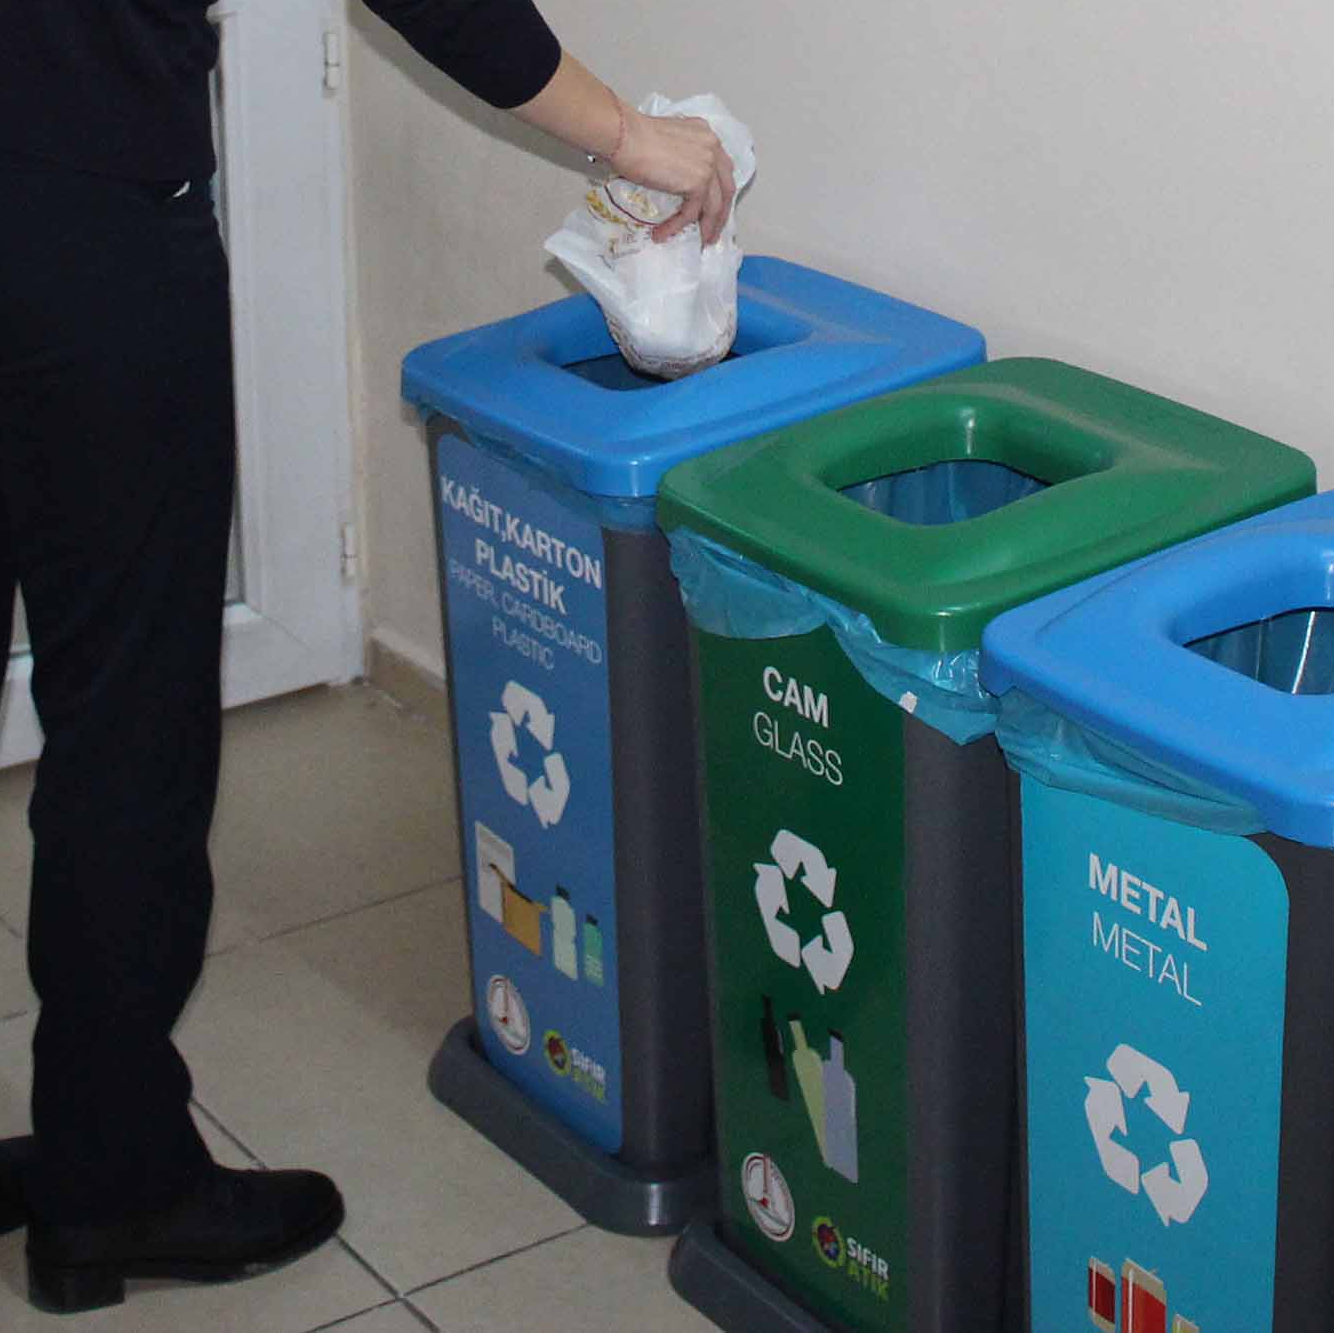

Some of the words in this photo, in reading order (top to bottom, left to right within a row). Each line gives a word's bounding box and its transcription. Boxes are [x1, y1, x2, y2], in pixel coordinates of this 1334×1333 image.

[474, 539, 567, 615] PLASTİK
[492, 617, 555, 670] PLASTIC
[502, 592, 603, 664] CARDBOARD
[762, 665, 830, 729] CAM
[753, 711, 844, 787] GLASS
[1088, 853, 1208, 952] METAL
[1092, 911, 1202, 1007] METAL
